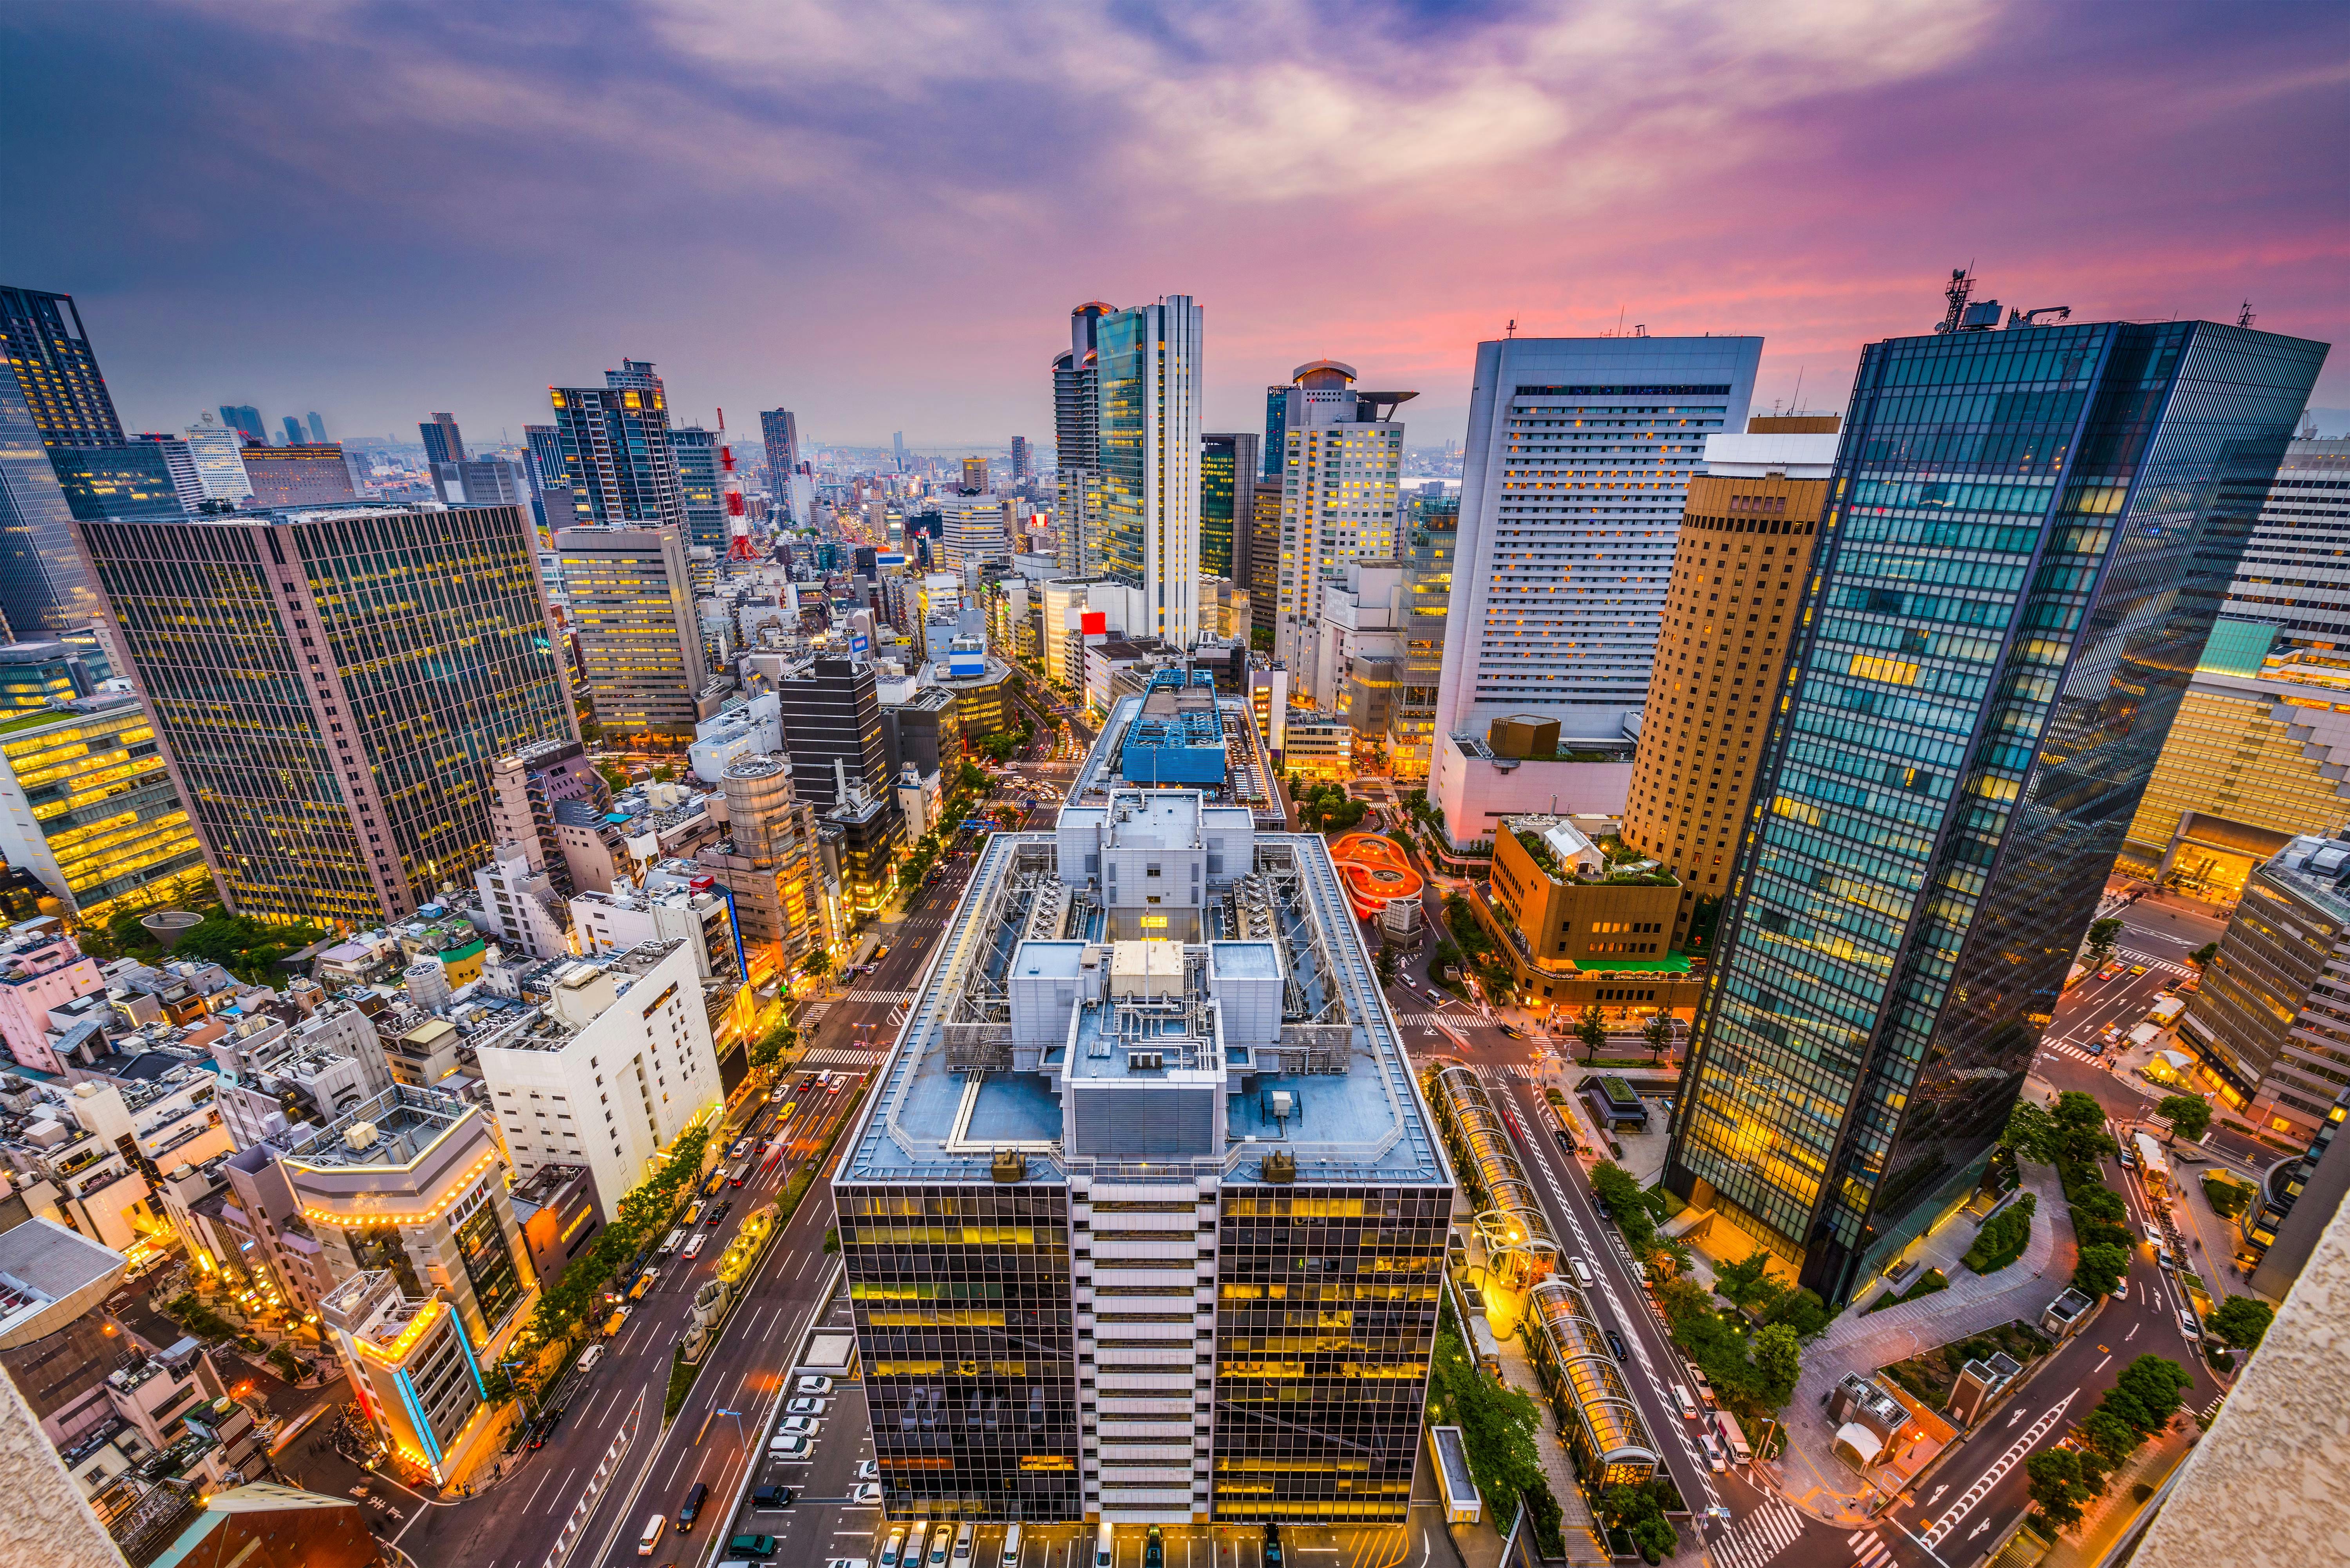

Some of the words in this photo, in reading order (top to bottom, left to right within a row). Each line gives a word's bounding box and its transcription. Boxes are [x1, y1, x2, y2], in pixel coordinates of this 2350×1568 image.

[927, 900, 937, 909] 50
[949, 900, 959, 909] 50
[912, 937, 923, 948] 50
[822, 1155, 841, 1178] 50
